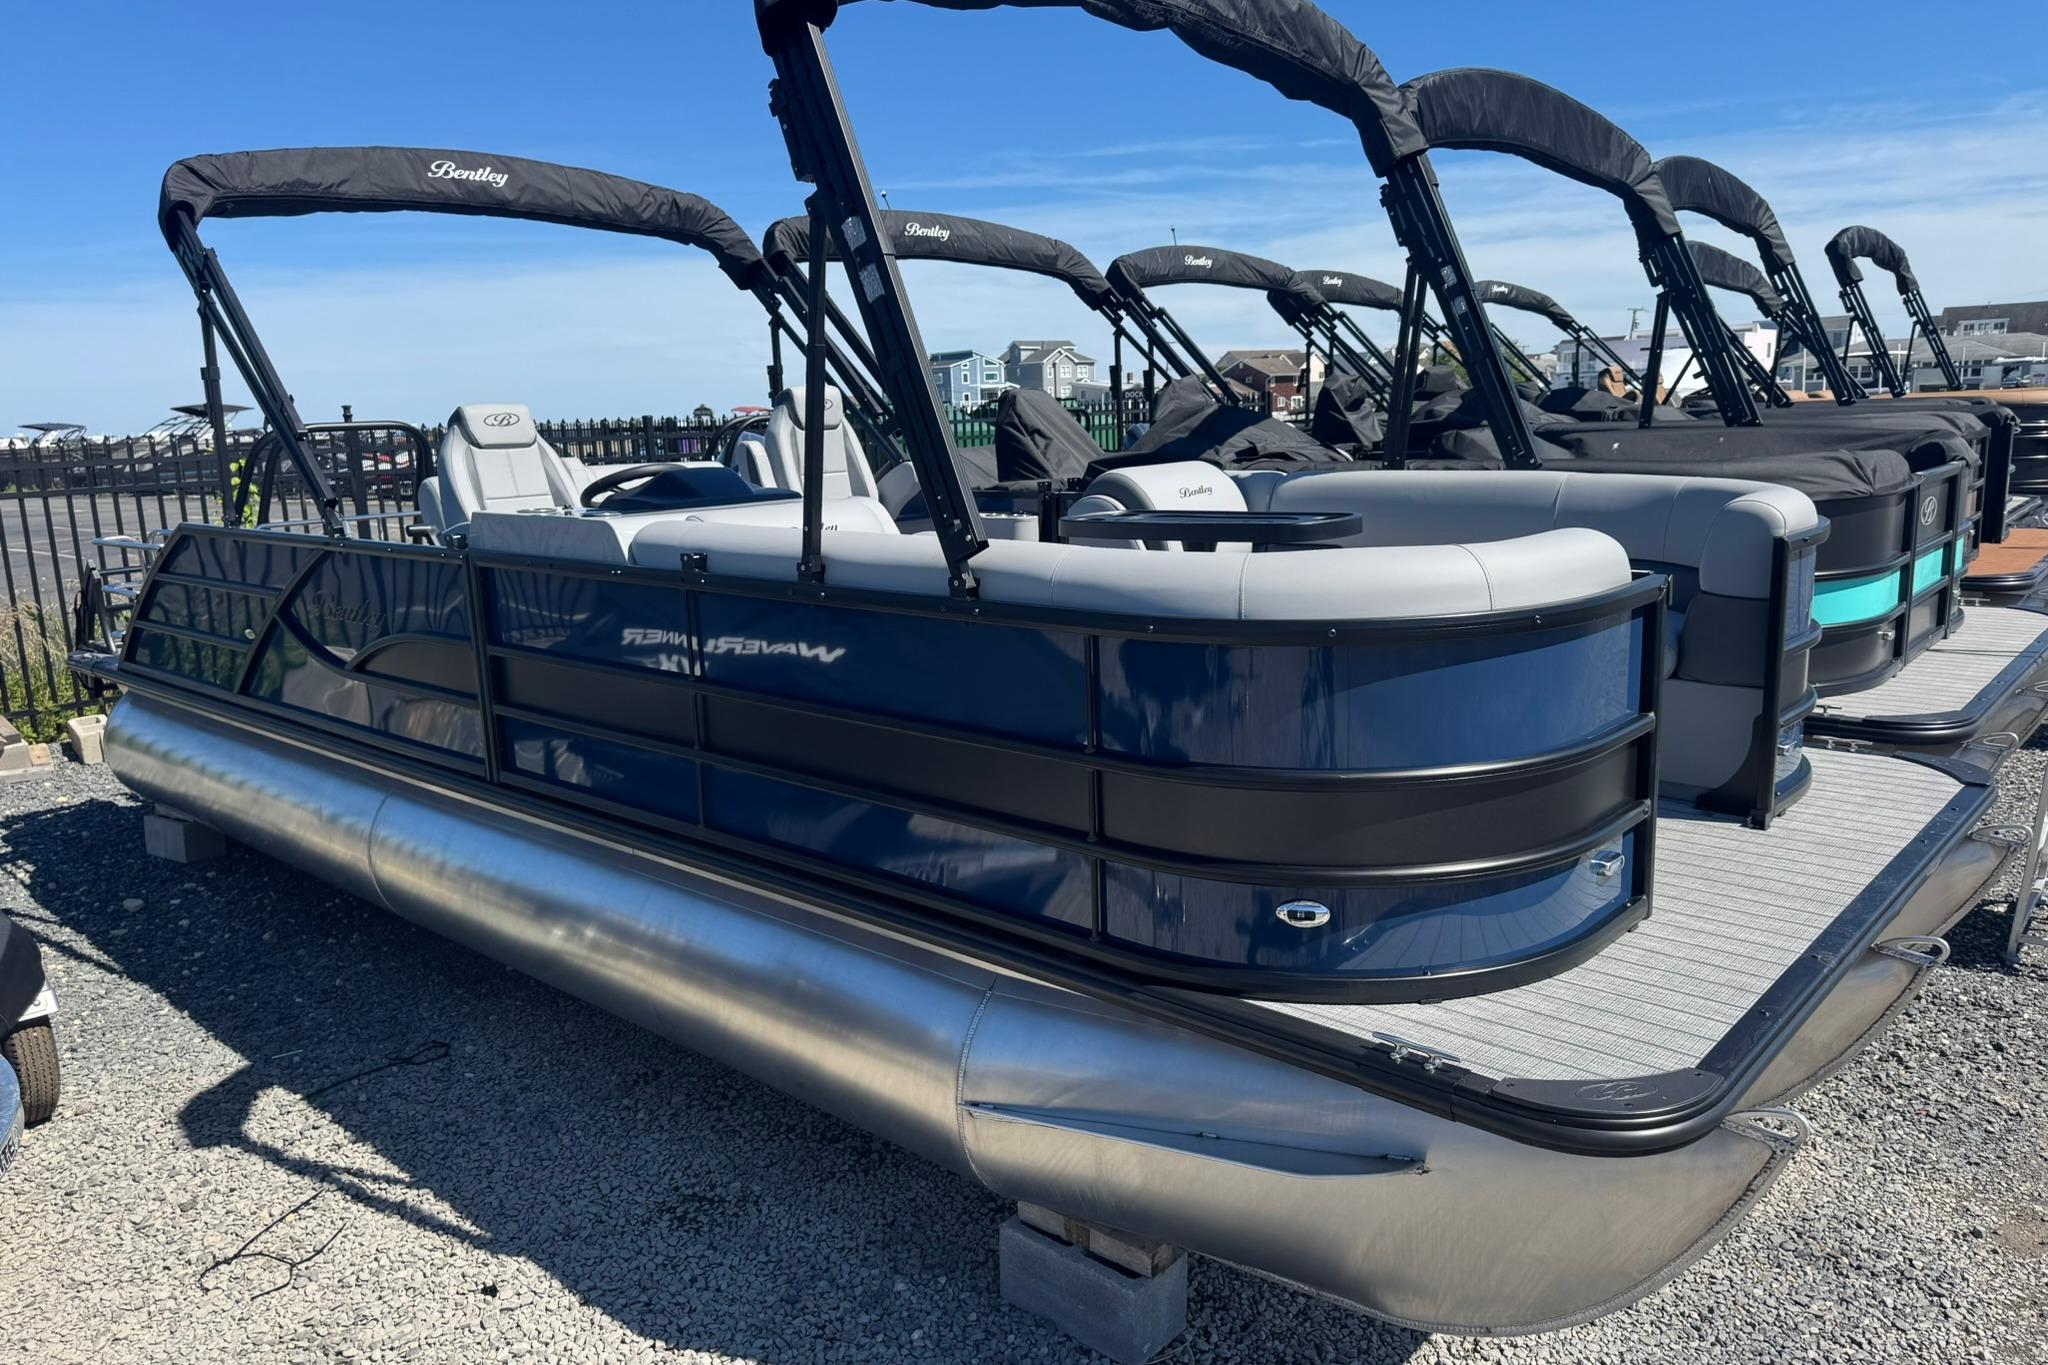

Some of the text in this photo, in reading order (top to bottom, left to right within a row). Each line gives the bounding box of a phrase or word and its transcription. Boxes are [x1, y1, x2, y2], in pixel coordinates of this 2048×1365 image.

[427, 160, 508, 188] Bentley
[904, 222, 950, 242] Bentley
[1179, 484, 1213, 499] Bentley
